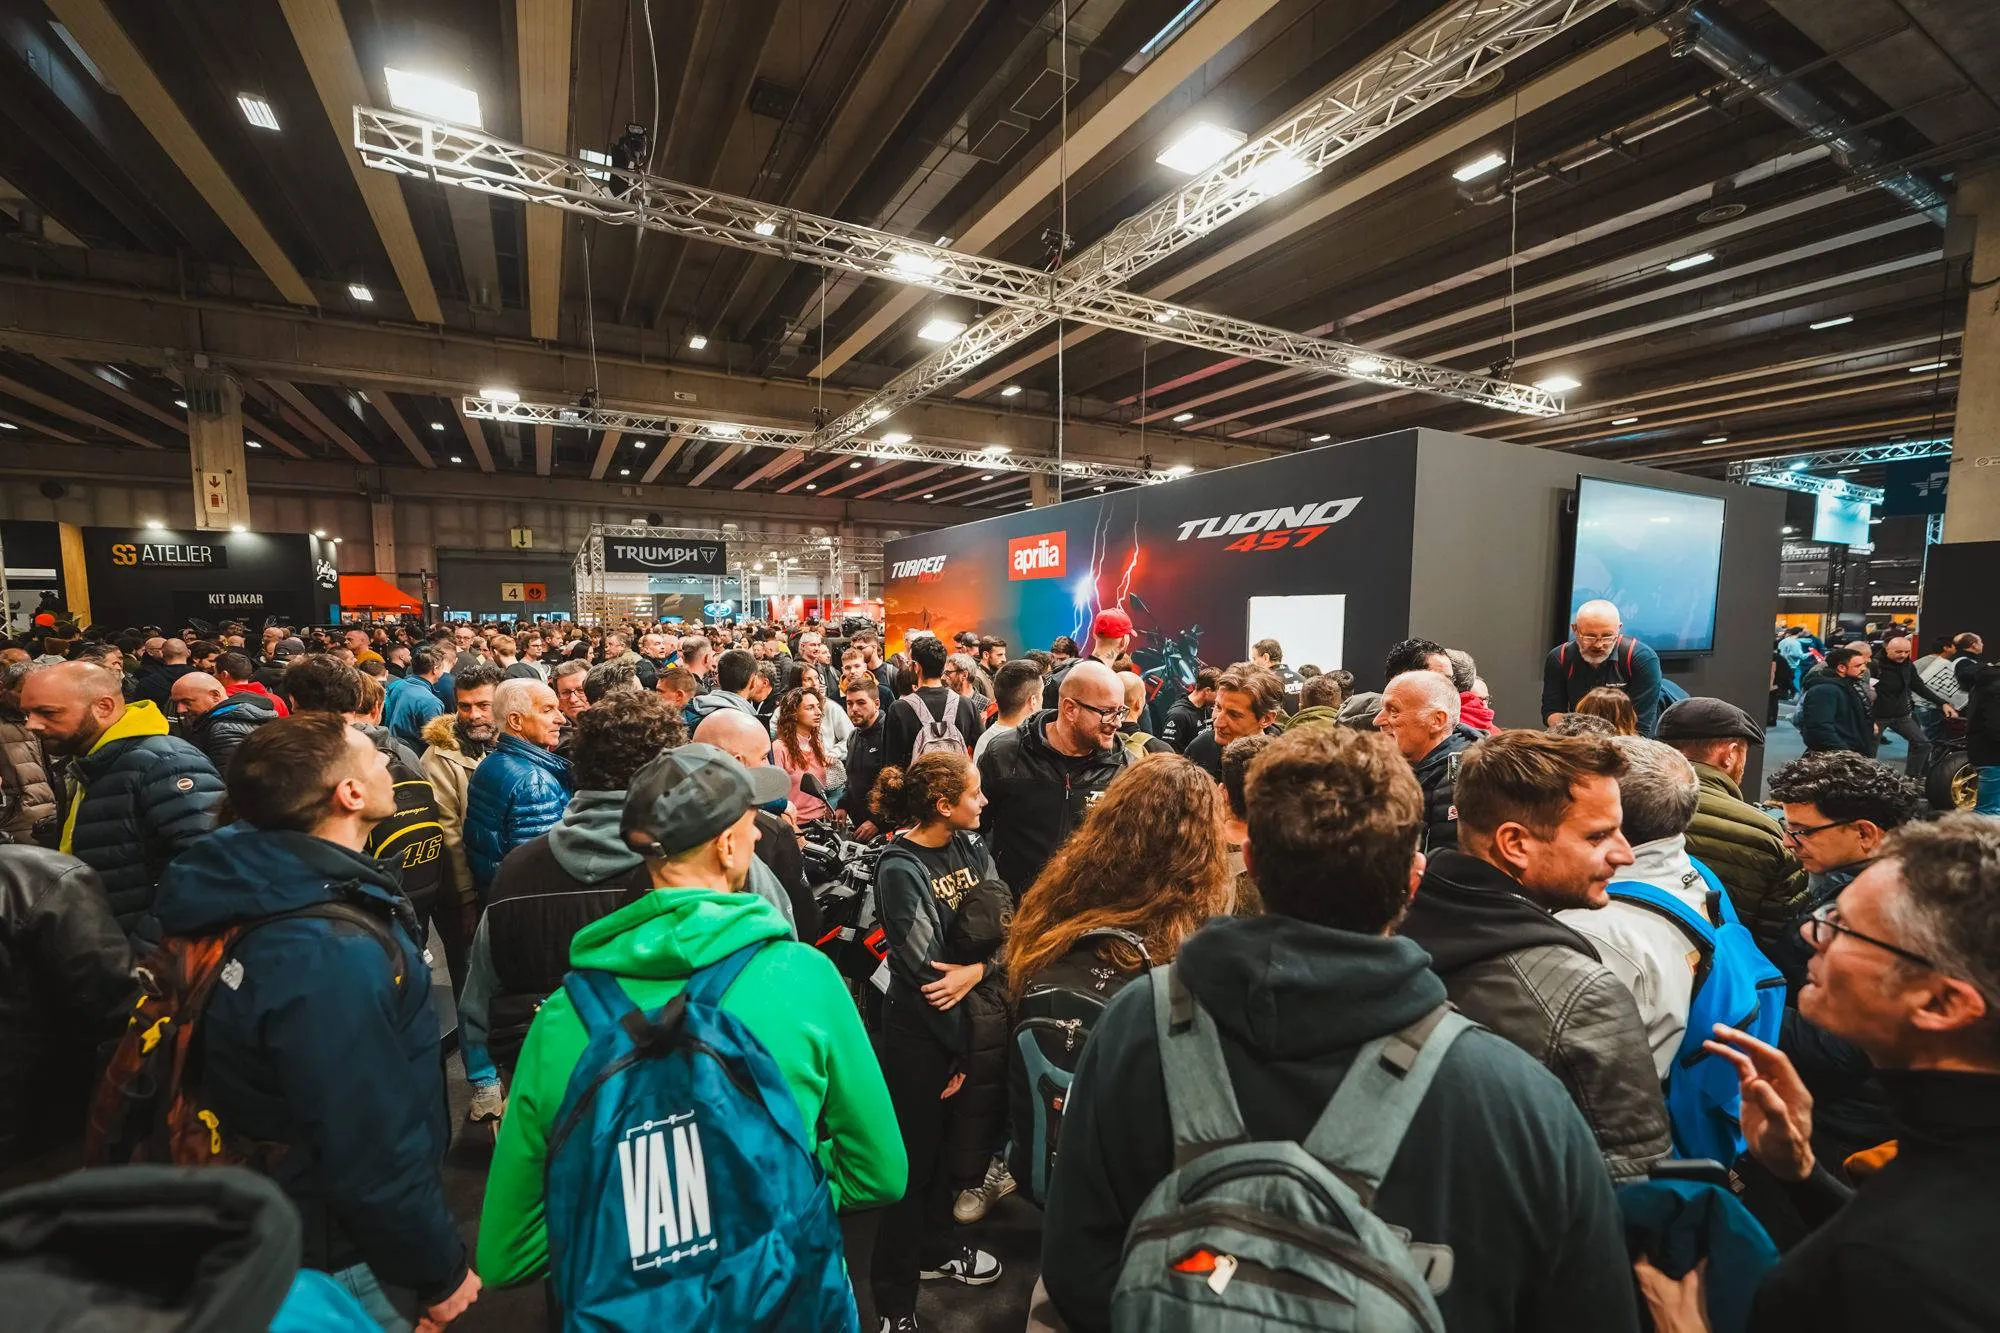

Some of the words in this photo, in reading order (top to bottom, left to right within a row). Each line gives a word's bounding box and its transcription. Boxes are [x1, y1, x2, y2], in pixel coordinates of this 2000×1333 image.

[1177, 497, 1363, 541] TUONO
[1223, 526, 1330, 552] 457
[112, 544, 137, 565] SG
[142, 544, 212, 562] ATELIER
[614, 545, 698, 567] TRIUMPH
[1014, 539, 1059, 575] aprilia
[208, 594, 225, 604] KIT
[228, 594, 263, 604] DAKAR
[509, 588, 518, 599] 4
[618, 1122, 711, 1258] VAN
